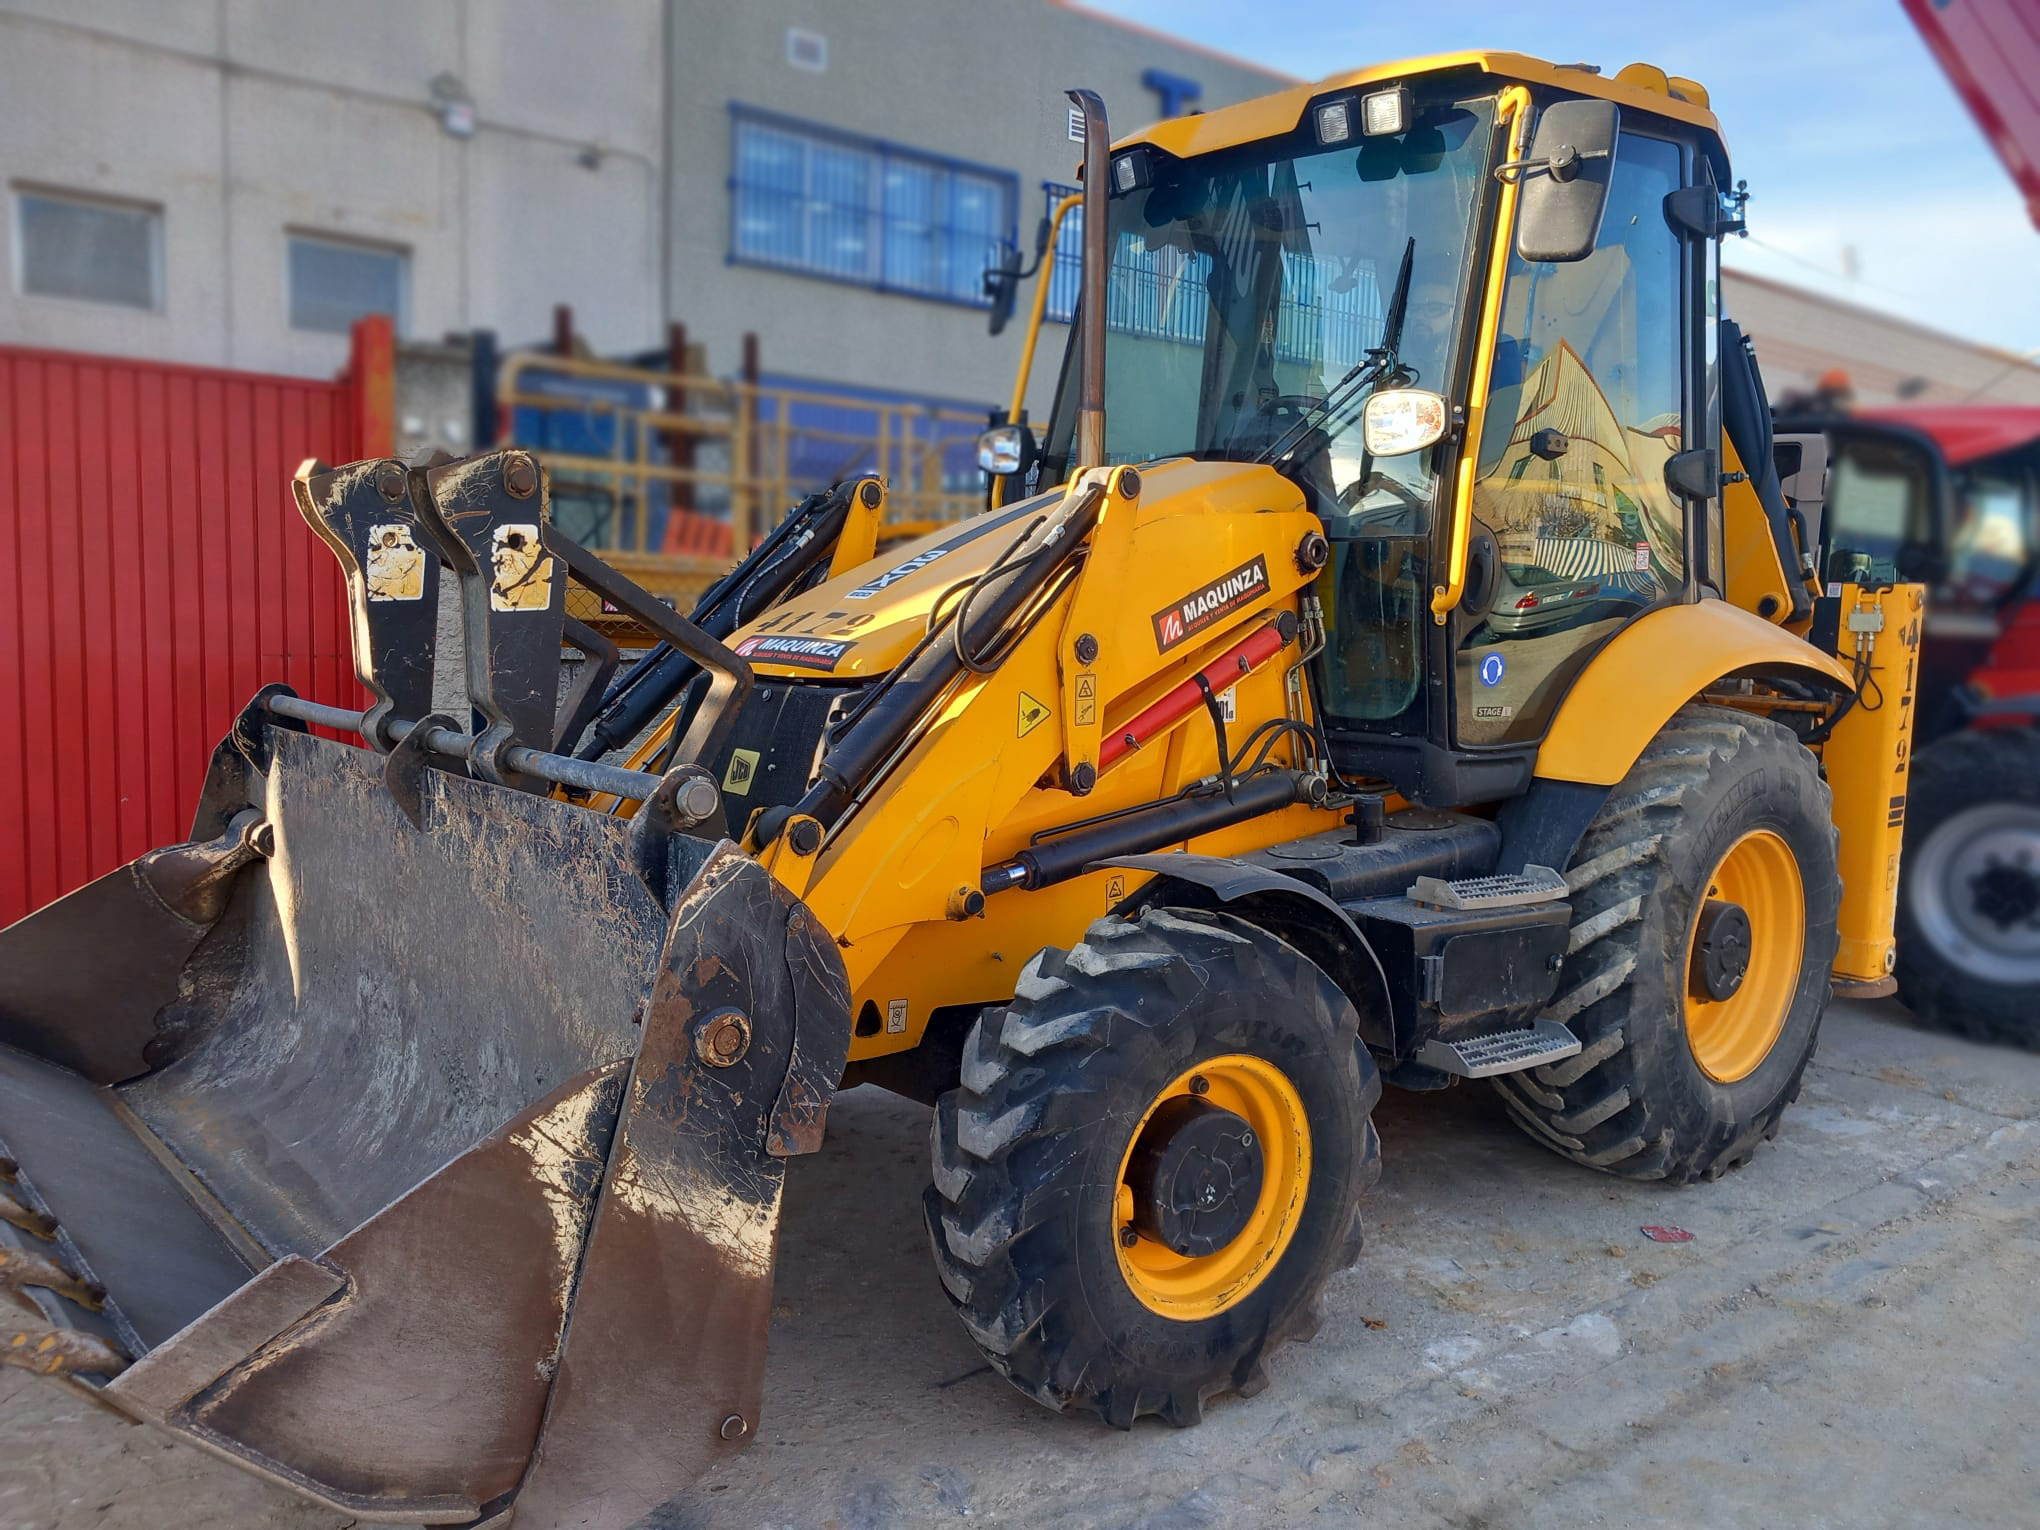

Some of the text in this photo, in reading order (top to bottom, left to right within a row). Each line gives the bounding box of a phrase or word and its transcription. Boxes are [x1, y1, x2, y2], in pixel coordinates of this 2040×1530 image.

[1182, 564, 1264, 624] MAQUINZA
[757, 638, 846, 658] MAQUINZA
[1477, 706, 1503, 717] STAGE
